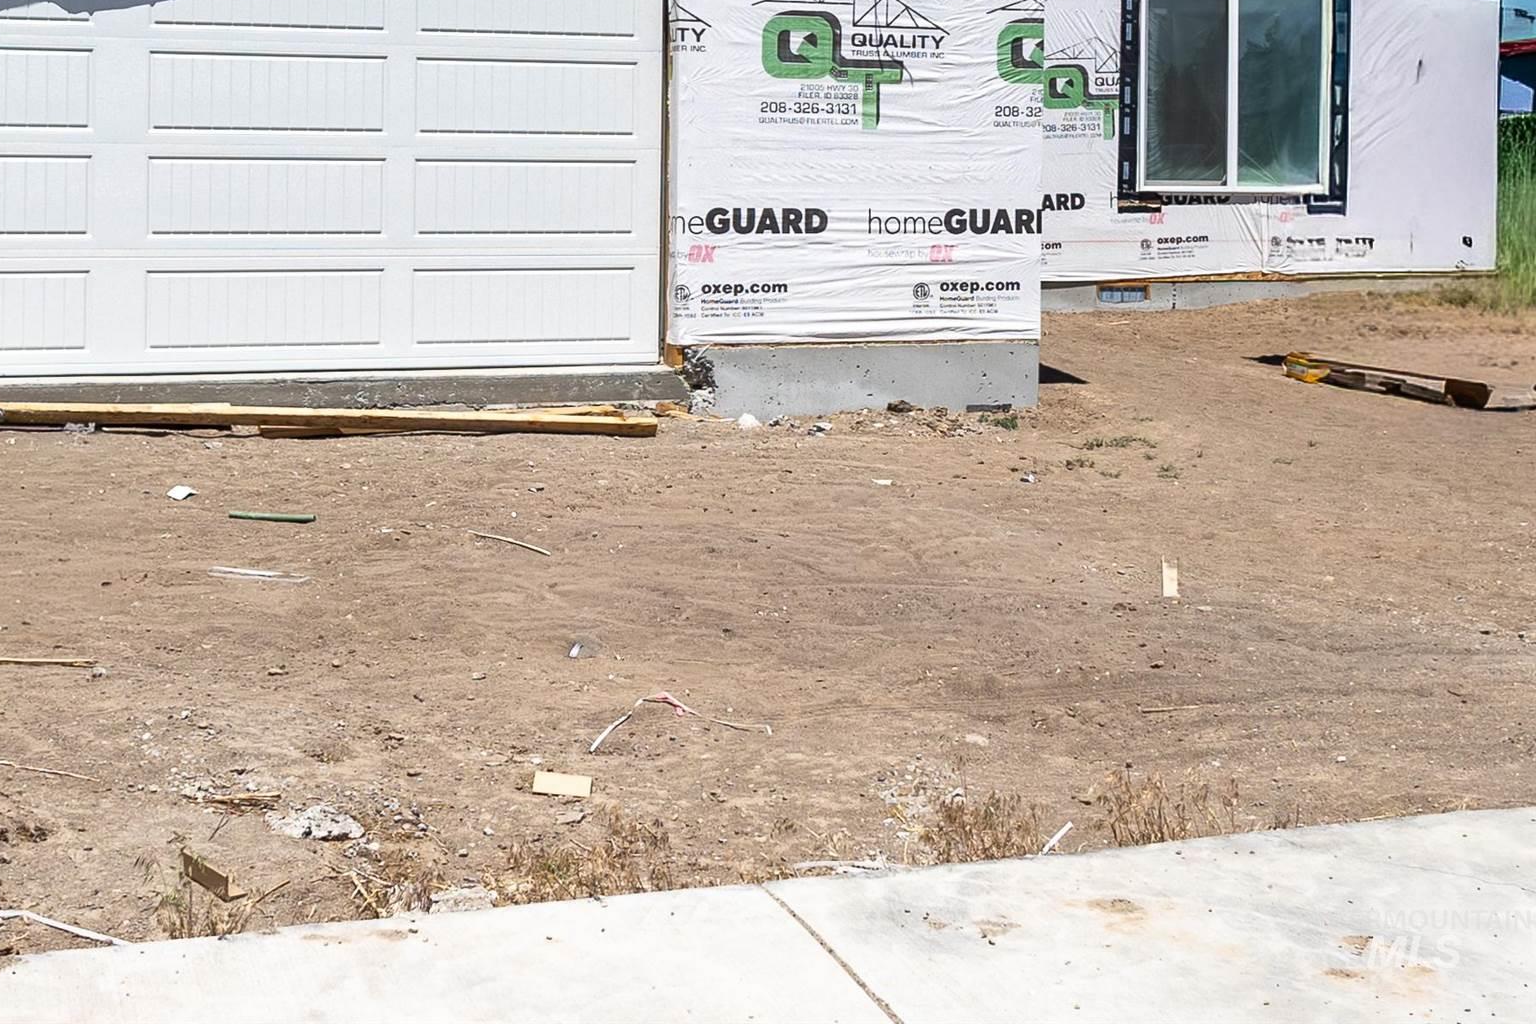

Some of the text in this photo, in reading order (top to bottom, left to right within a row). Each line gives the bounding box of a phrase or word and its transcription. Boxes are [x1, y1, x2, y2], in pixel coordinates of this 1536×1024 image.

[851, 32, 946, 50] QUALITY
[851, 50, 880, 58] TRUSS
[892, 51, 928, 59] LUMBER
[760, 101, 857, 115] 208-326-3131
[1157, 235, 1209, 245] oxep.com
[701, 282, 788, 296] oxep.com
[939, 280, 1021, 294] oxep.com
